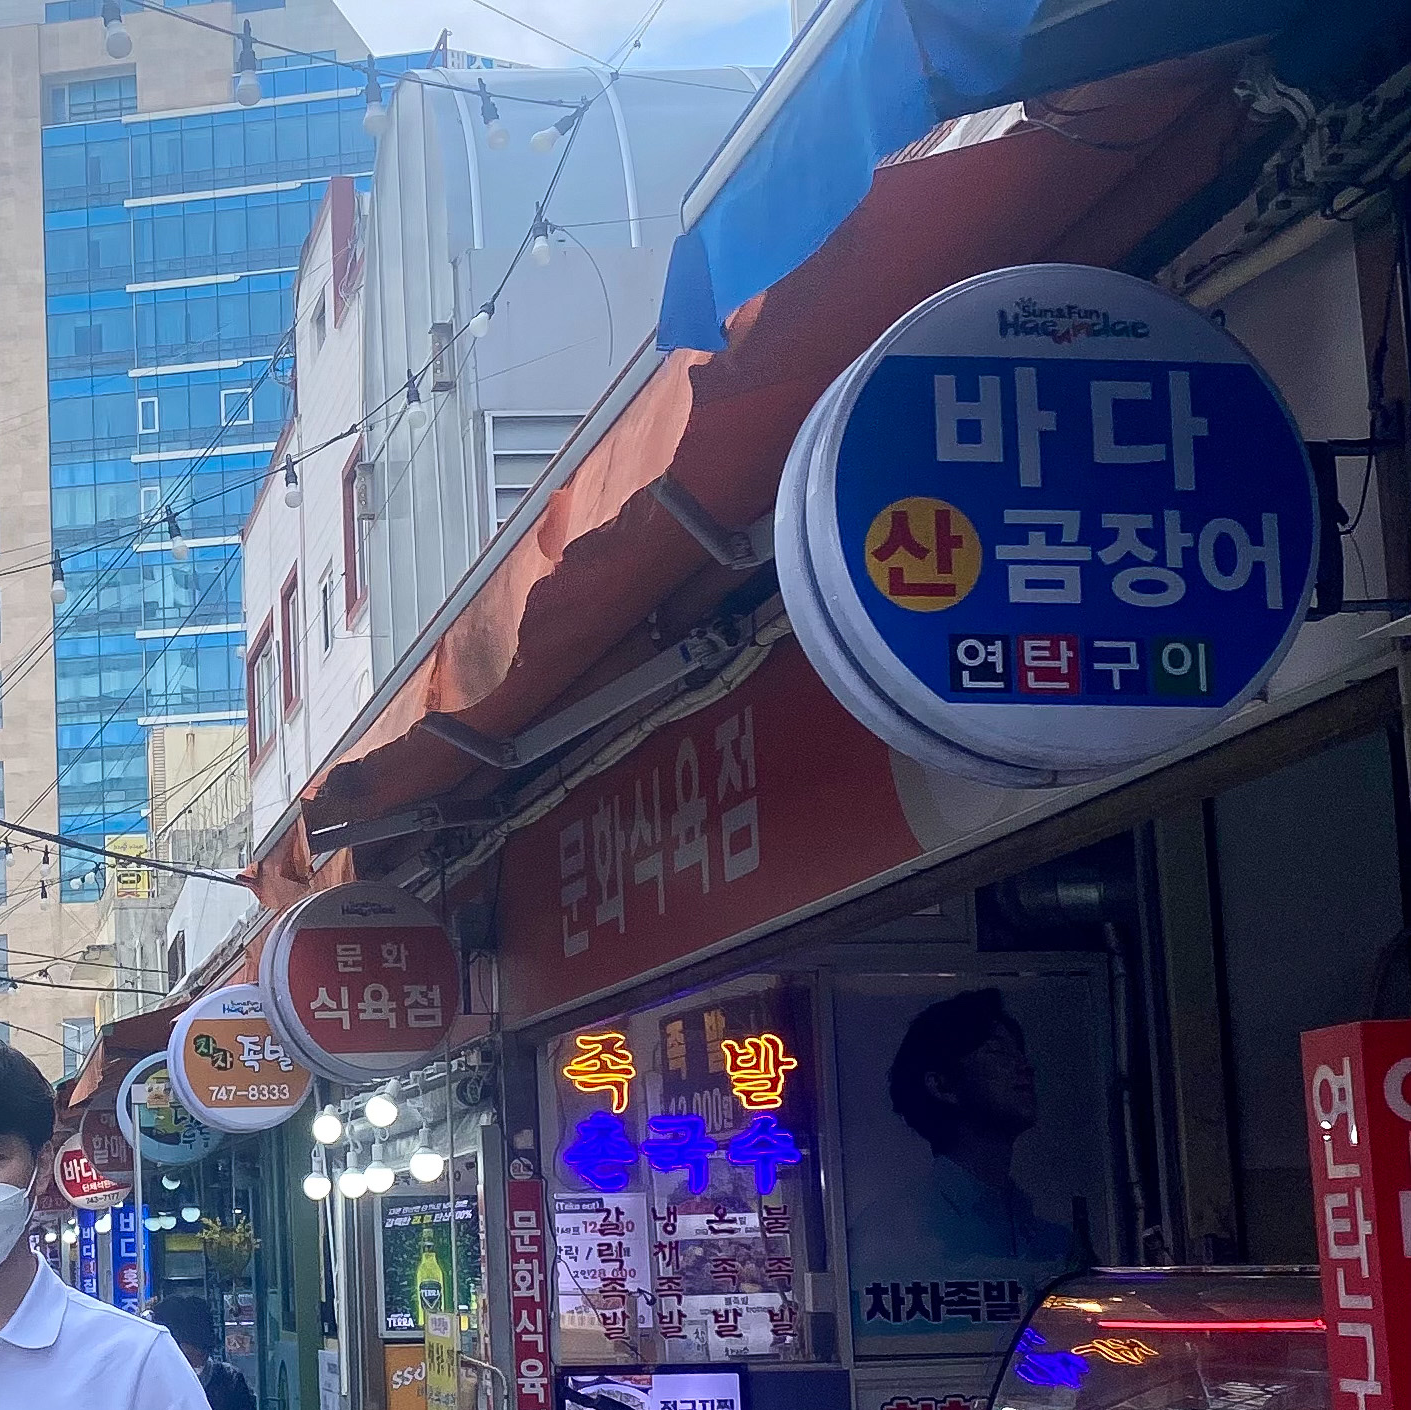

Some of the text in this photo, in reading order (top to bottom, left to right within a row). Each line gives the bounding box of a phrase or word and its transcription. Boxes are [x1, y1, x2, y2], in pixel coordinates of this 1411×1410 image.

[933, 366, 1209, 491] 바다
[870, 508, 1285, 610] 산 곰장어
[955, 638, 1209, 693] 연탄구이
[558, 703, 760, 959] 문화식육점
[335, 942, 410, 973] 문화
[310, 983, 443, 1031] 식육점
[208, 1083, 290, 1102] 747-8333
[562, 1031, 799, 1115] 족발
[562, 1110, 803, 1196] 촌국수
[594, 1206, 632, 1342] 갈릭족발
[650, 1204, 688, 1340] 냉채족발
[705, 1204, 744, 1339] 온족발
[761, 1204, 799, 1338] 불족발
[865, 1280, 1023, 1323] 차차족발
[386, 1316, 416, 1329] TERRA
